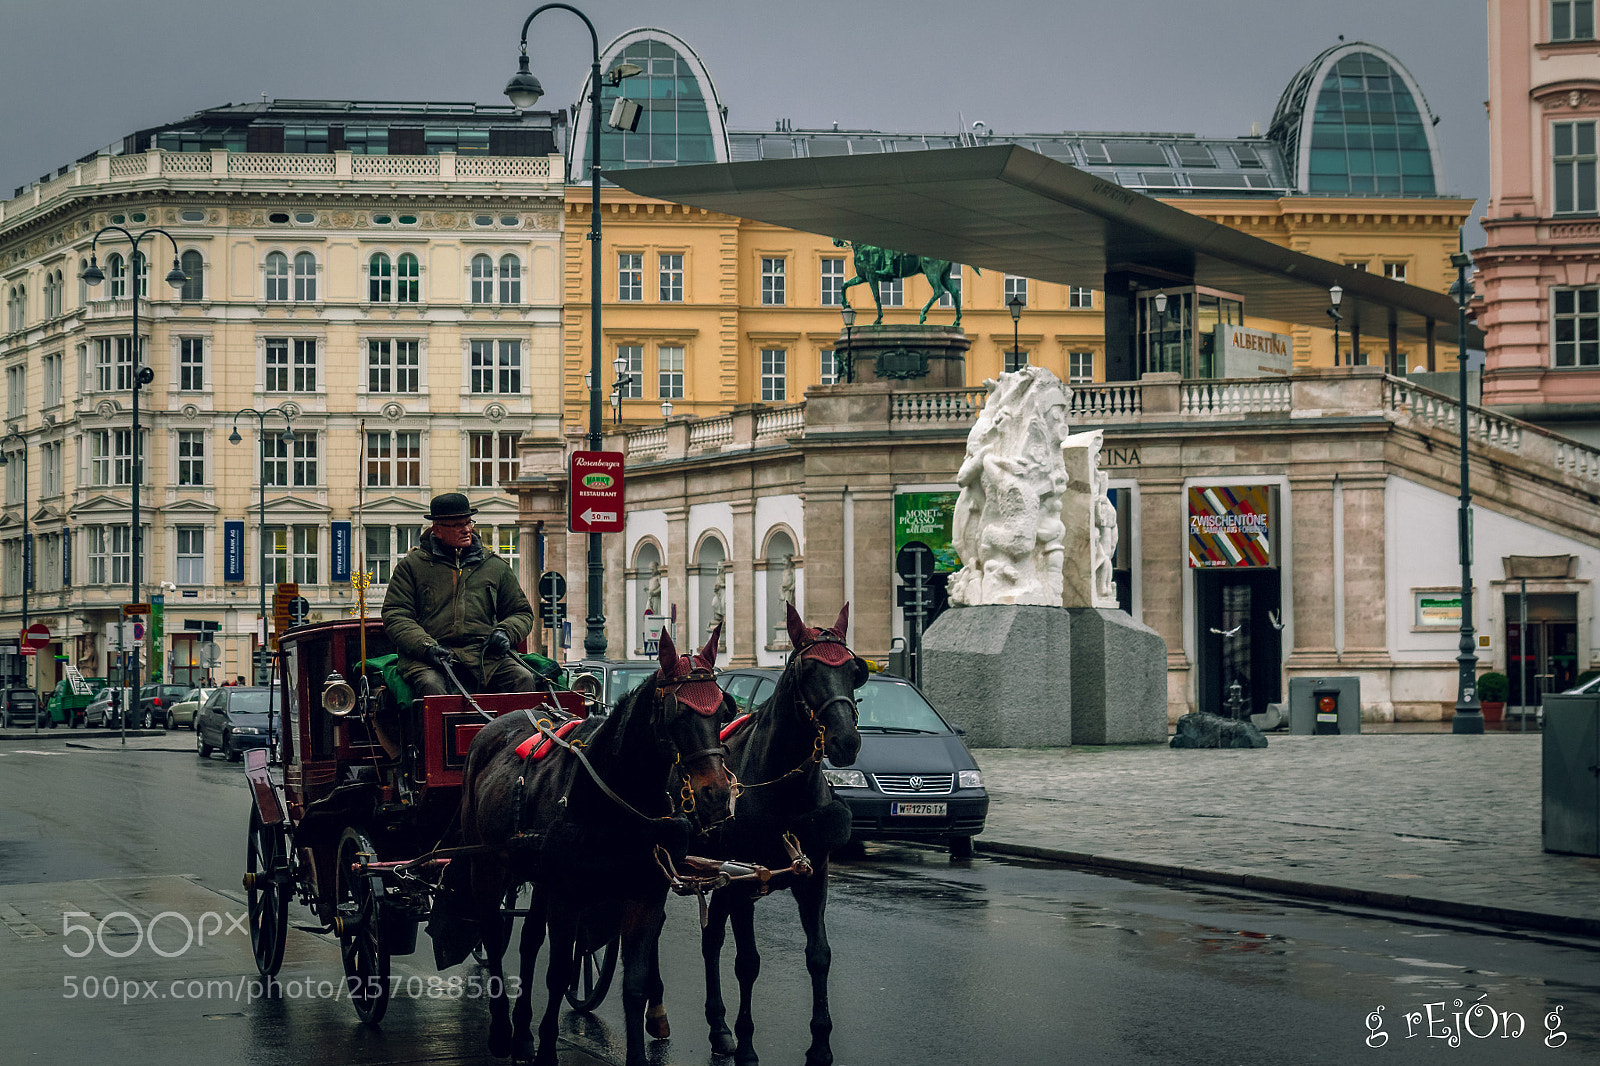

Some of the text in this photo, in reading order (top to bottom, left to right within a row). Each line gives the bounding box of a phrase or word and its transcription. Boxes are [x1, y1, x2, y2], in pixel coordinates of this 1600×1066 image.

[1232, 331, 1287, 357] ALBERTINA
[575, 457, 620, 470] Rosenberger
[906, 509, 937, 517] MONET
[899, 516, 935, 525] PICASSO
[1190, 513, 1267, 527] ZWISCHENTÖNE
[912, 805, 932, 814] 1276
